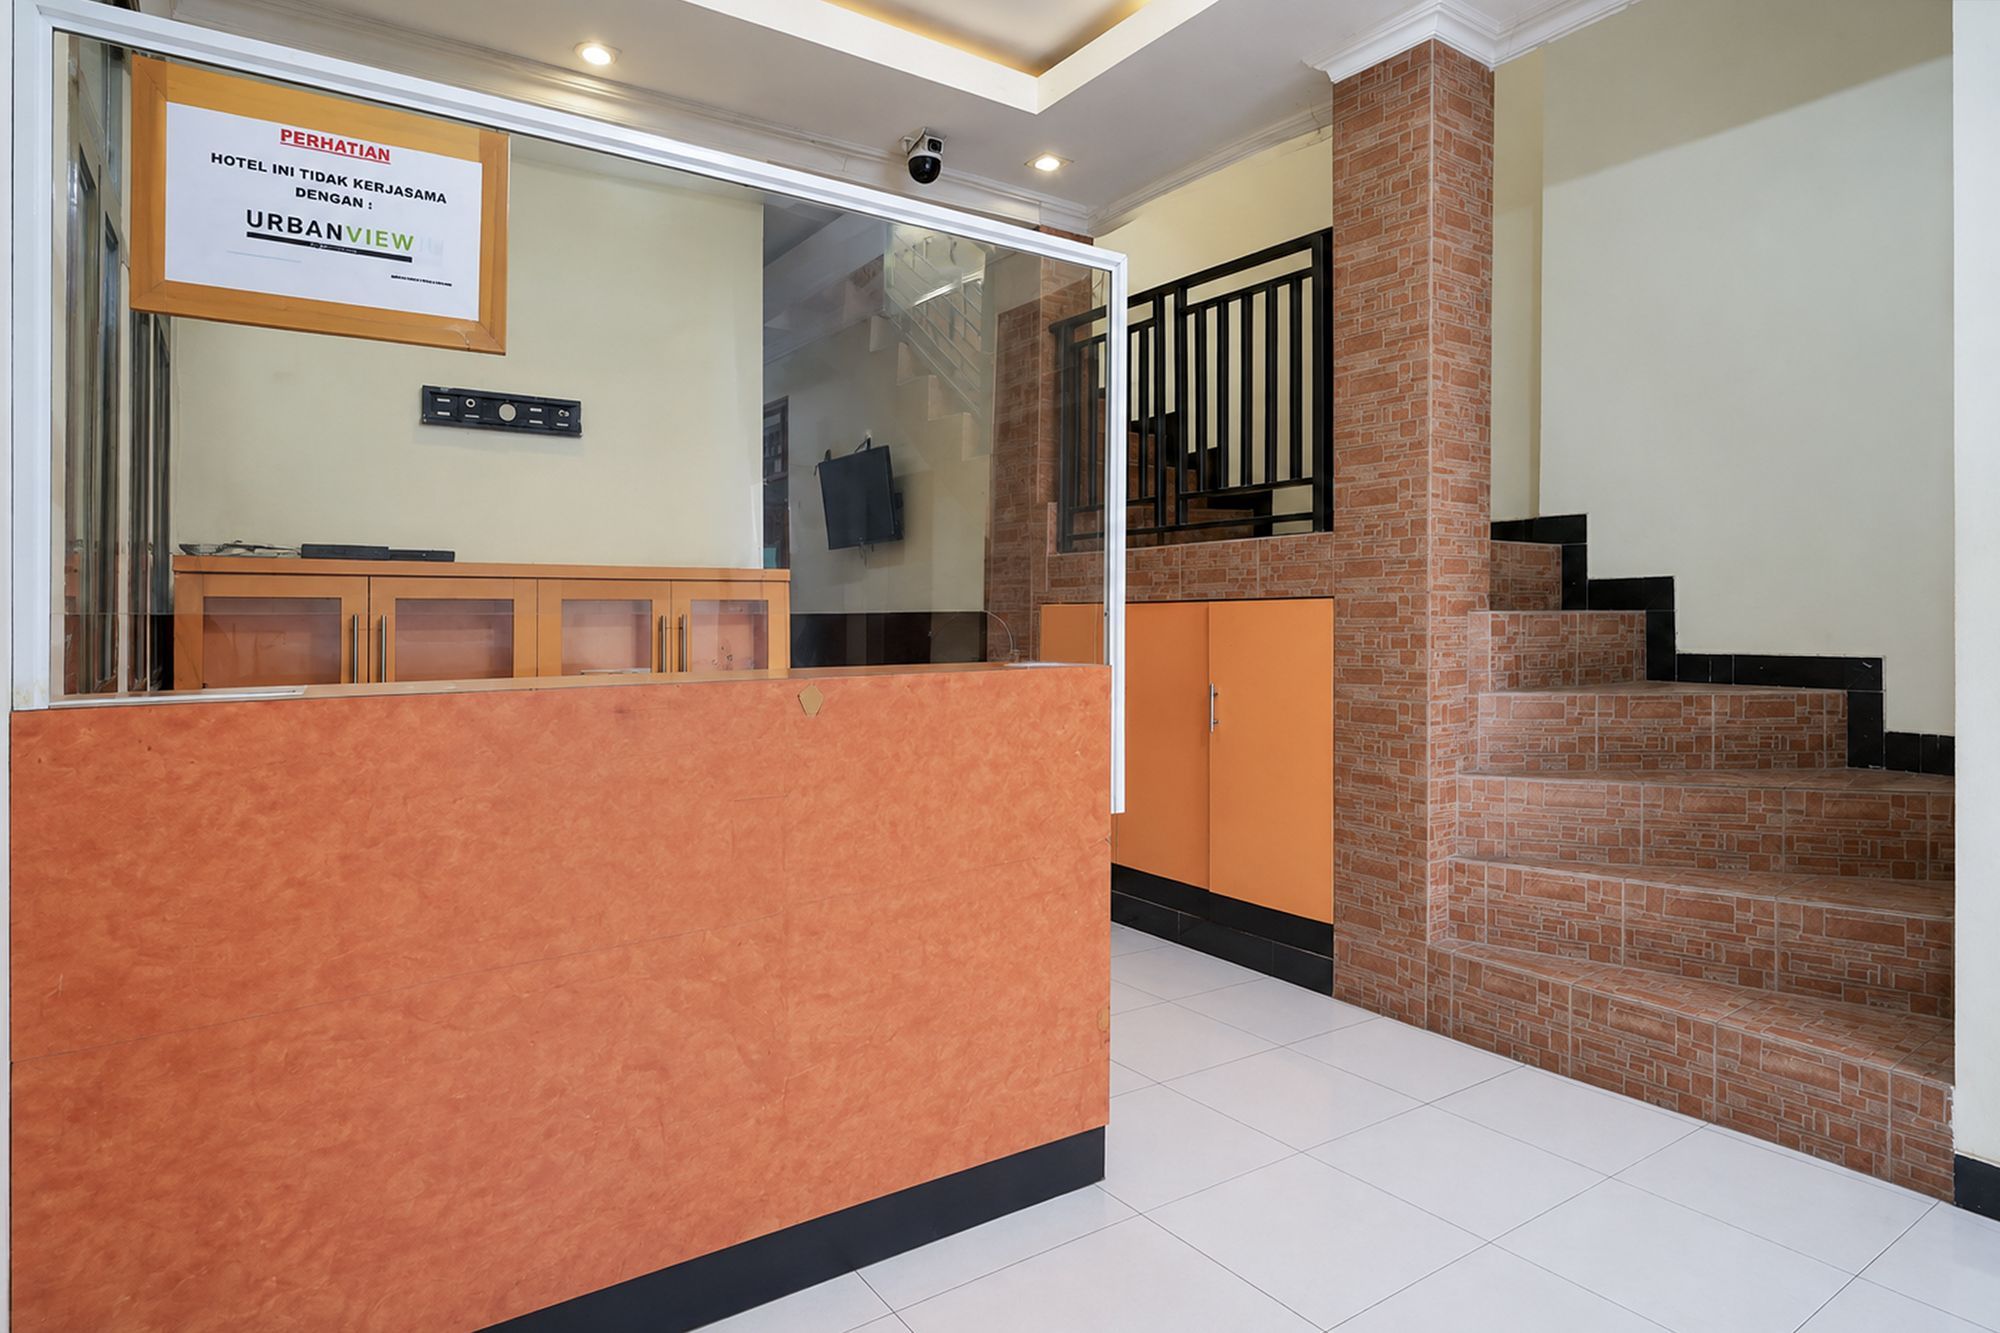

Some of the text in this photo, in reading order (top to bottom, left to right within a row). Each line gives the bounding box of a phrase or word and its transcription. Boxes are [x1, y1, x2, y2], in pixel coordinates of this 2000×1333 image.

[280, 128, 391, 162] PERHATIAN
[211, 152, 447, 204] HOTEL INI TIDAK KERJASAMA
[295, 186, 364, 209] DENGAN
[246, 209, 415, 251] URBANVIEW
